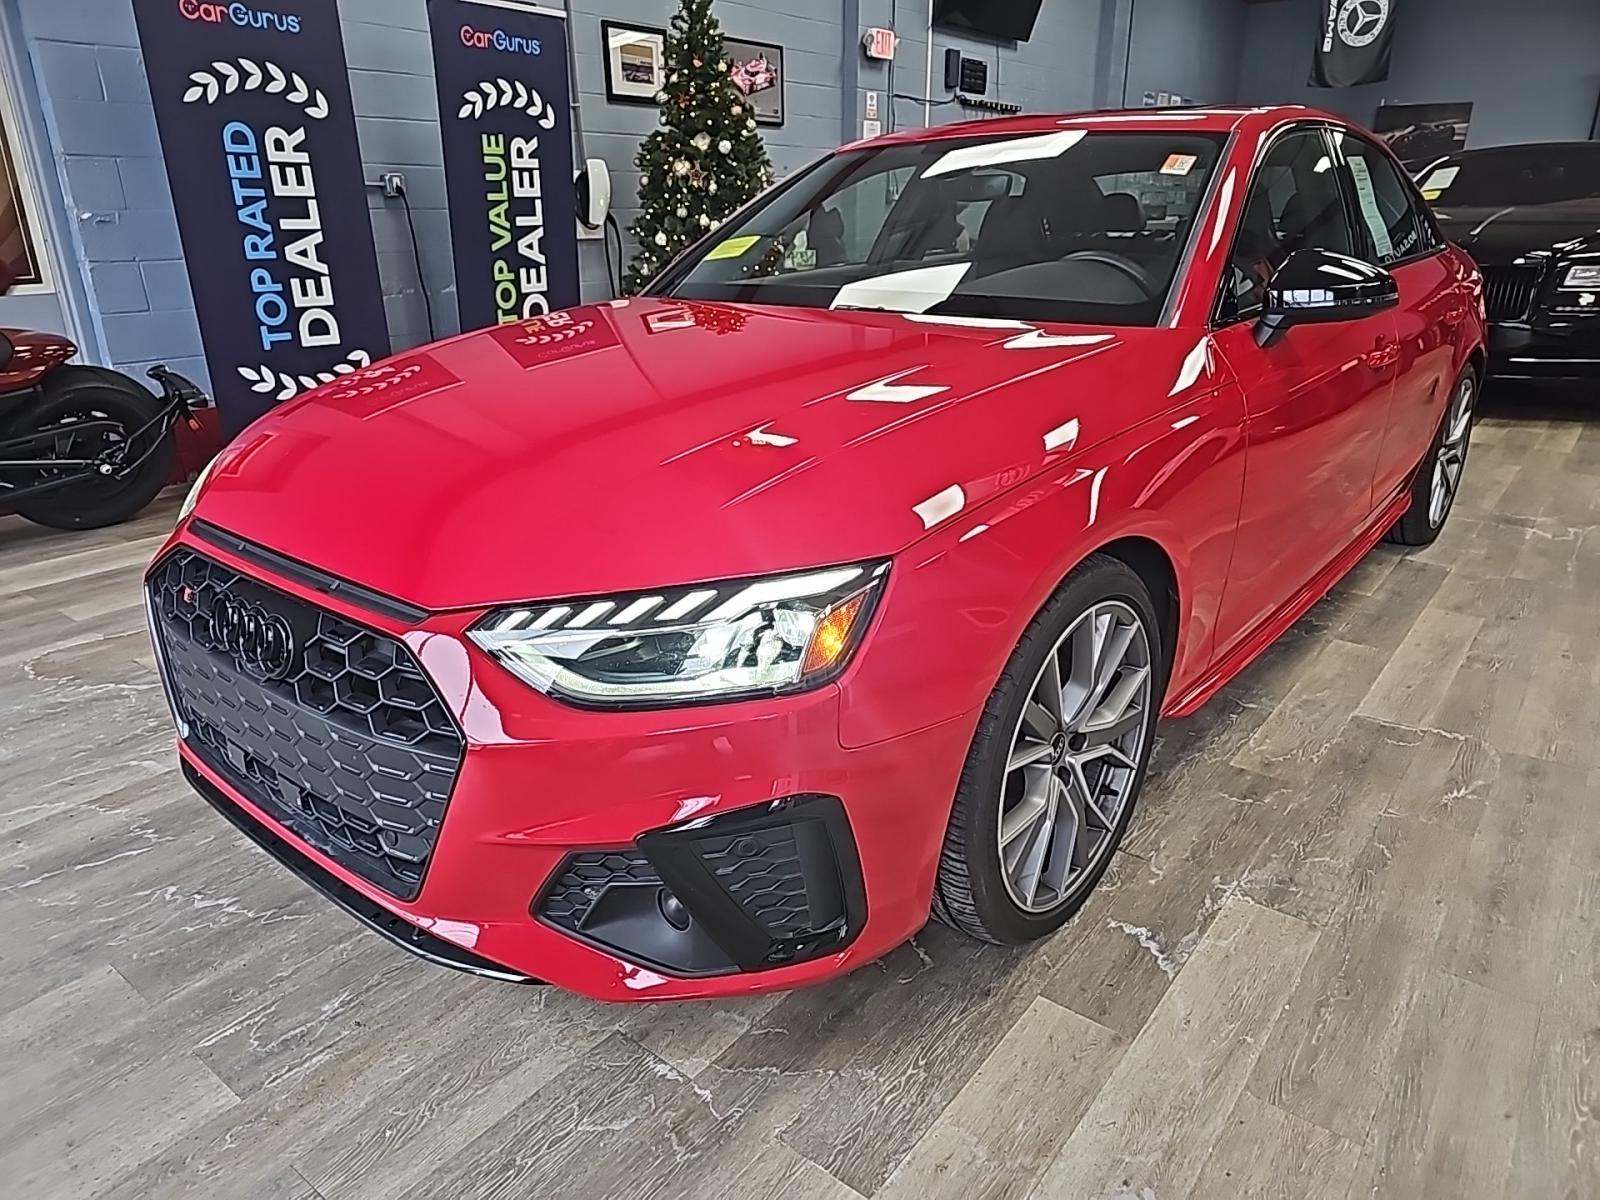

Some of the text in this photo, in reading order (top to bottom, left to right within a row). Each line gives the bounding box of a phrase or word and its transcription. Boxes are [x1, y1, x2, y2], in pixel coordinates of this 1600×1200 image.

[179, 0, 300, 33] CarGurus
[460, 25, 541, 55] CarGurus
[875, 30, 892, 56] EXIT
[222, 121, 292, 350] TOP RATED
[264, 126, 341, 347] DEALER
[481, 134, 518, 325] TOP VALUE
[510, 136, 549, 320] DEALER
